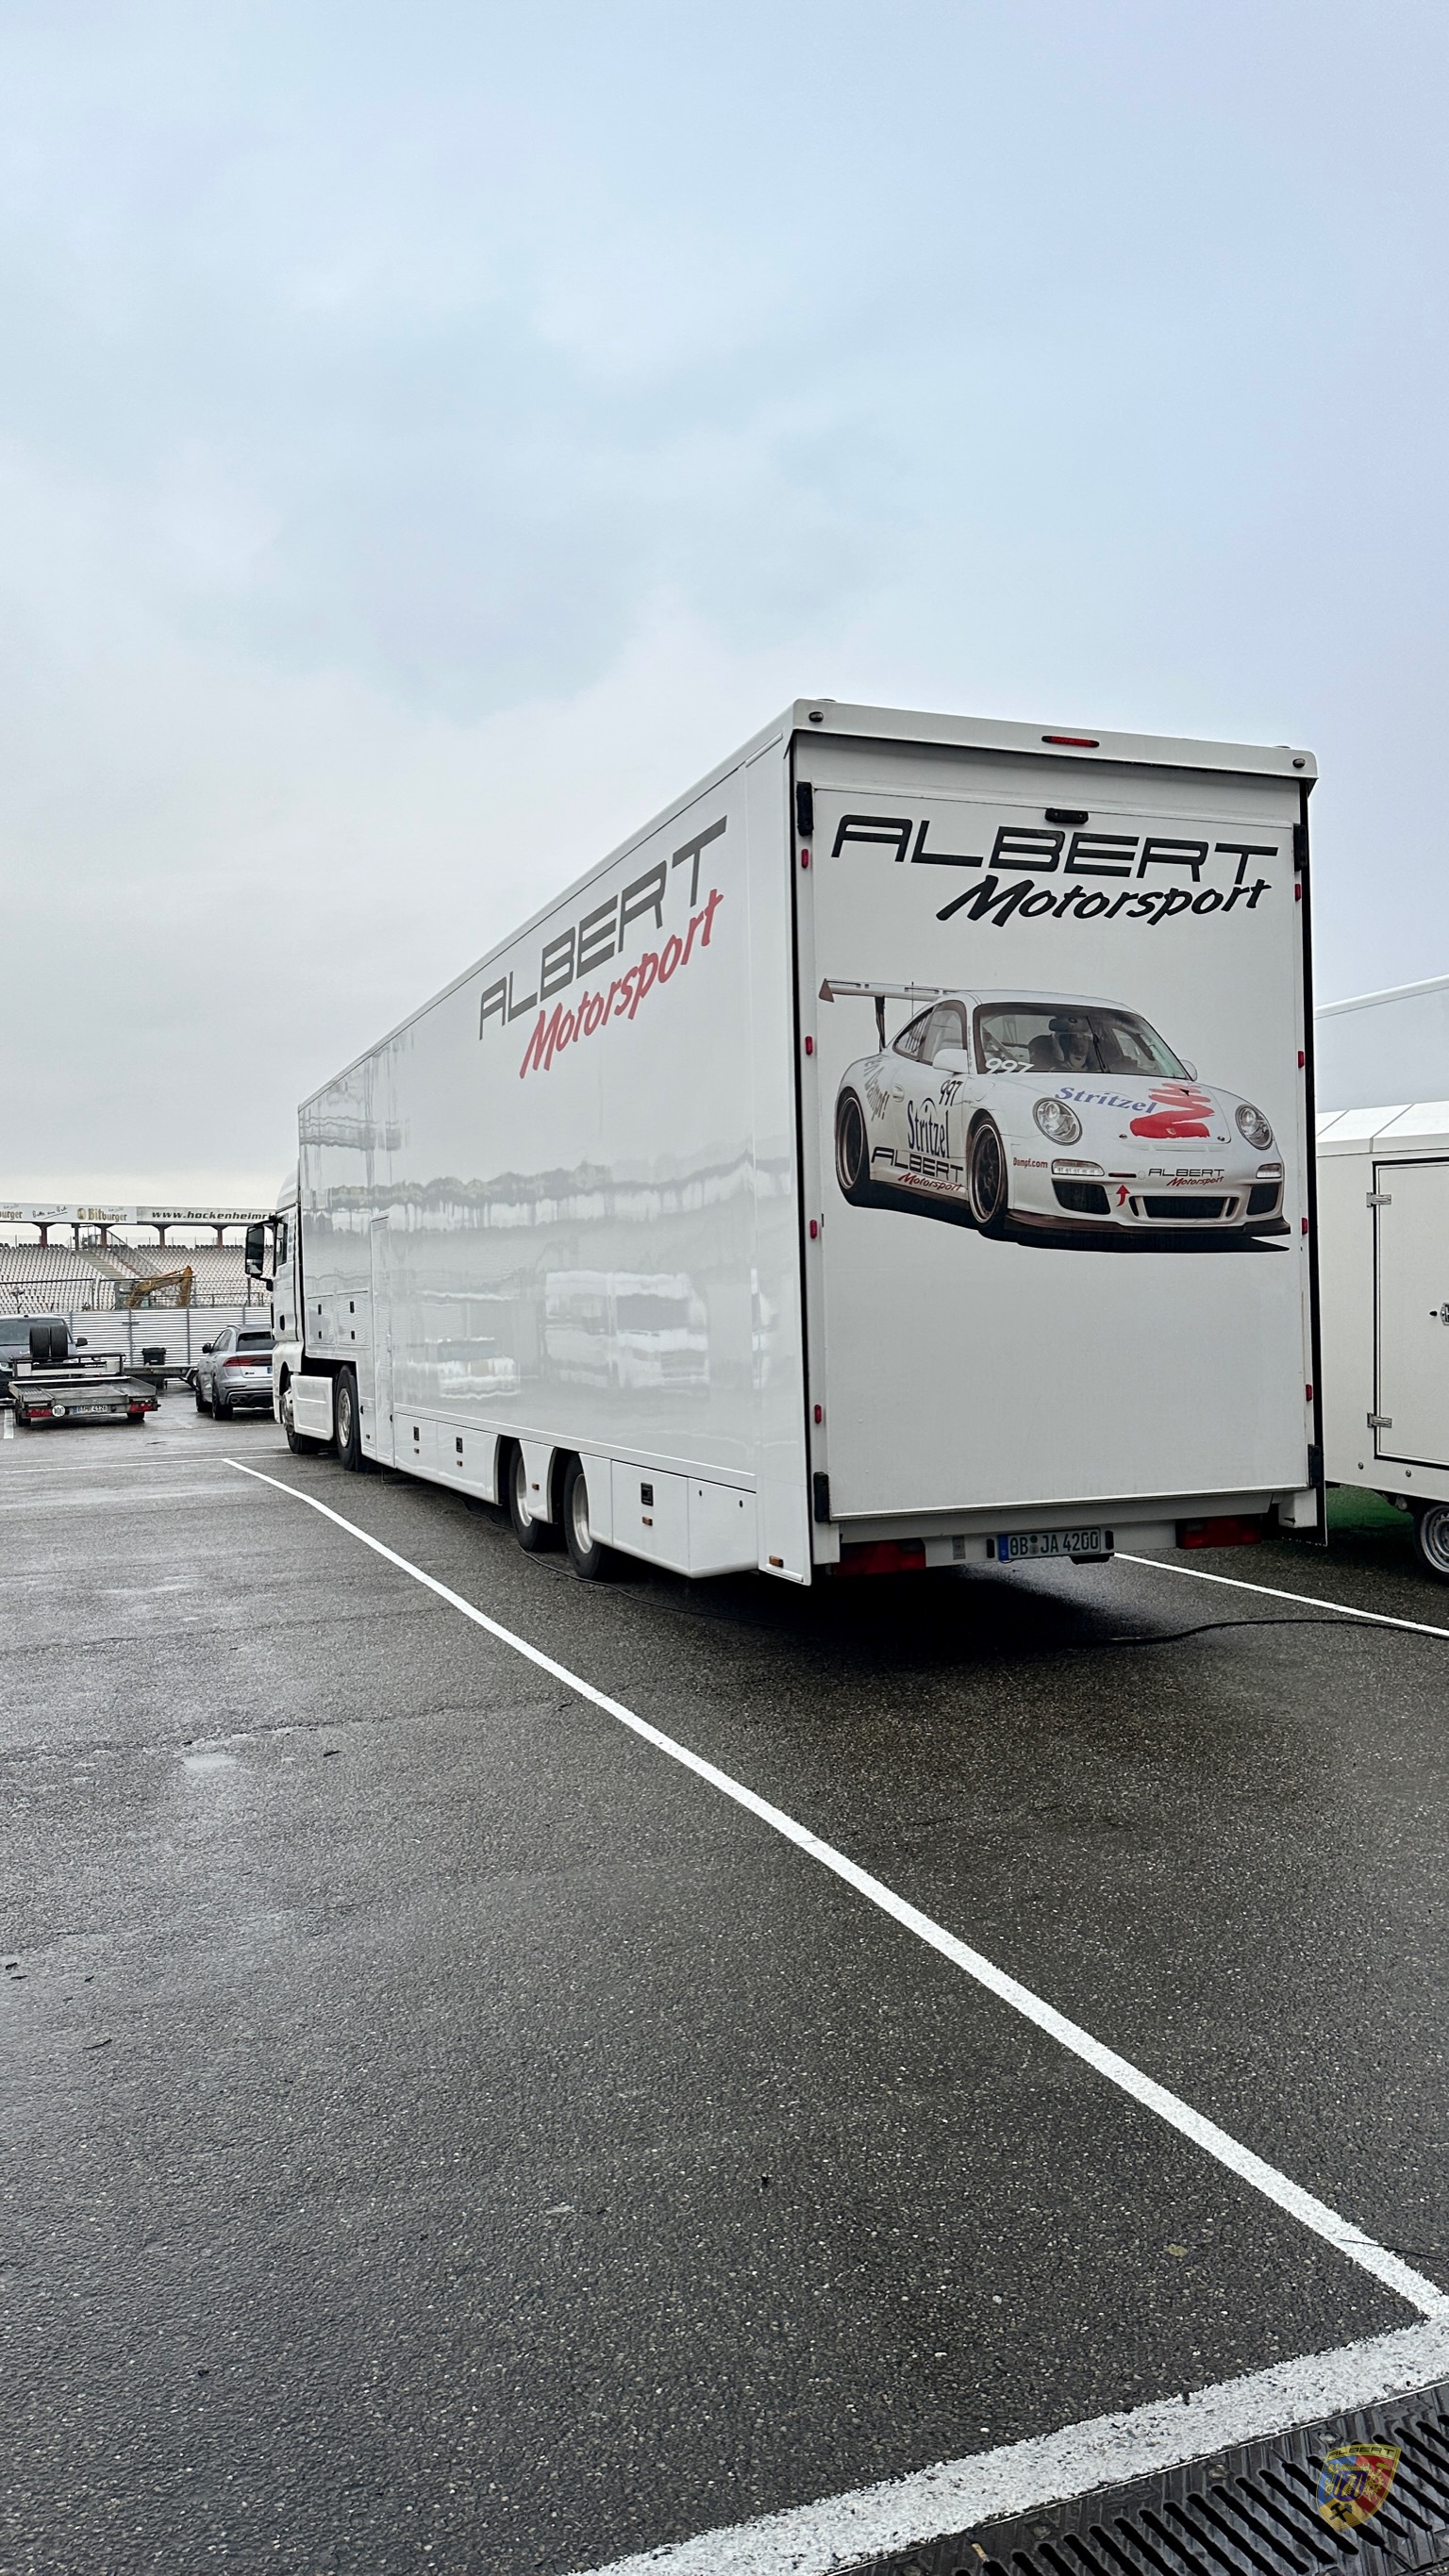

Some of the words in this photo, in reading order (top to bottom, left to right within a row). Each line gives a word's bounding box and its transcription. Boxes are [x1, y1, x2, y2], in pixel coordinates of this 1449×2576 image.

[831, 814, 1278, 885] ALBERT
[936, 874, 1272, 927] Motorsport
[479, 815, 727, 1040] ALBERT
[519, 889, 724, 1079] Motorsport
[985, 1057, 1035, 1074] 997
[939, 1079, 964, 1107] 997
[1054, 1087, 1158, 1114] Stritzel
[907, 1098, 951, 1159] Stritzel
[871, 1146, 964, 1183] ALBERT
[1012, 1156, 1049, 1169] Dampf.com
[1148, 1168, 1224, 1177] ALBERT
[897, 1172, 964, 1192] Motorsport
[1166, 1175, 1224, 1187] Motorsport
[88, 1207, 127, 1222] Bitburger
[152, 1210, 275, 1221] www.hockenheimri
[1041, 1534, 1058, 1554] JA
[1063, 1531, 1099, 1552] 4200
